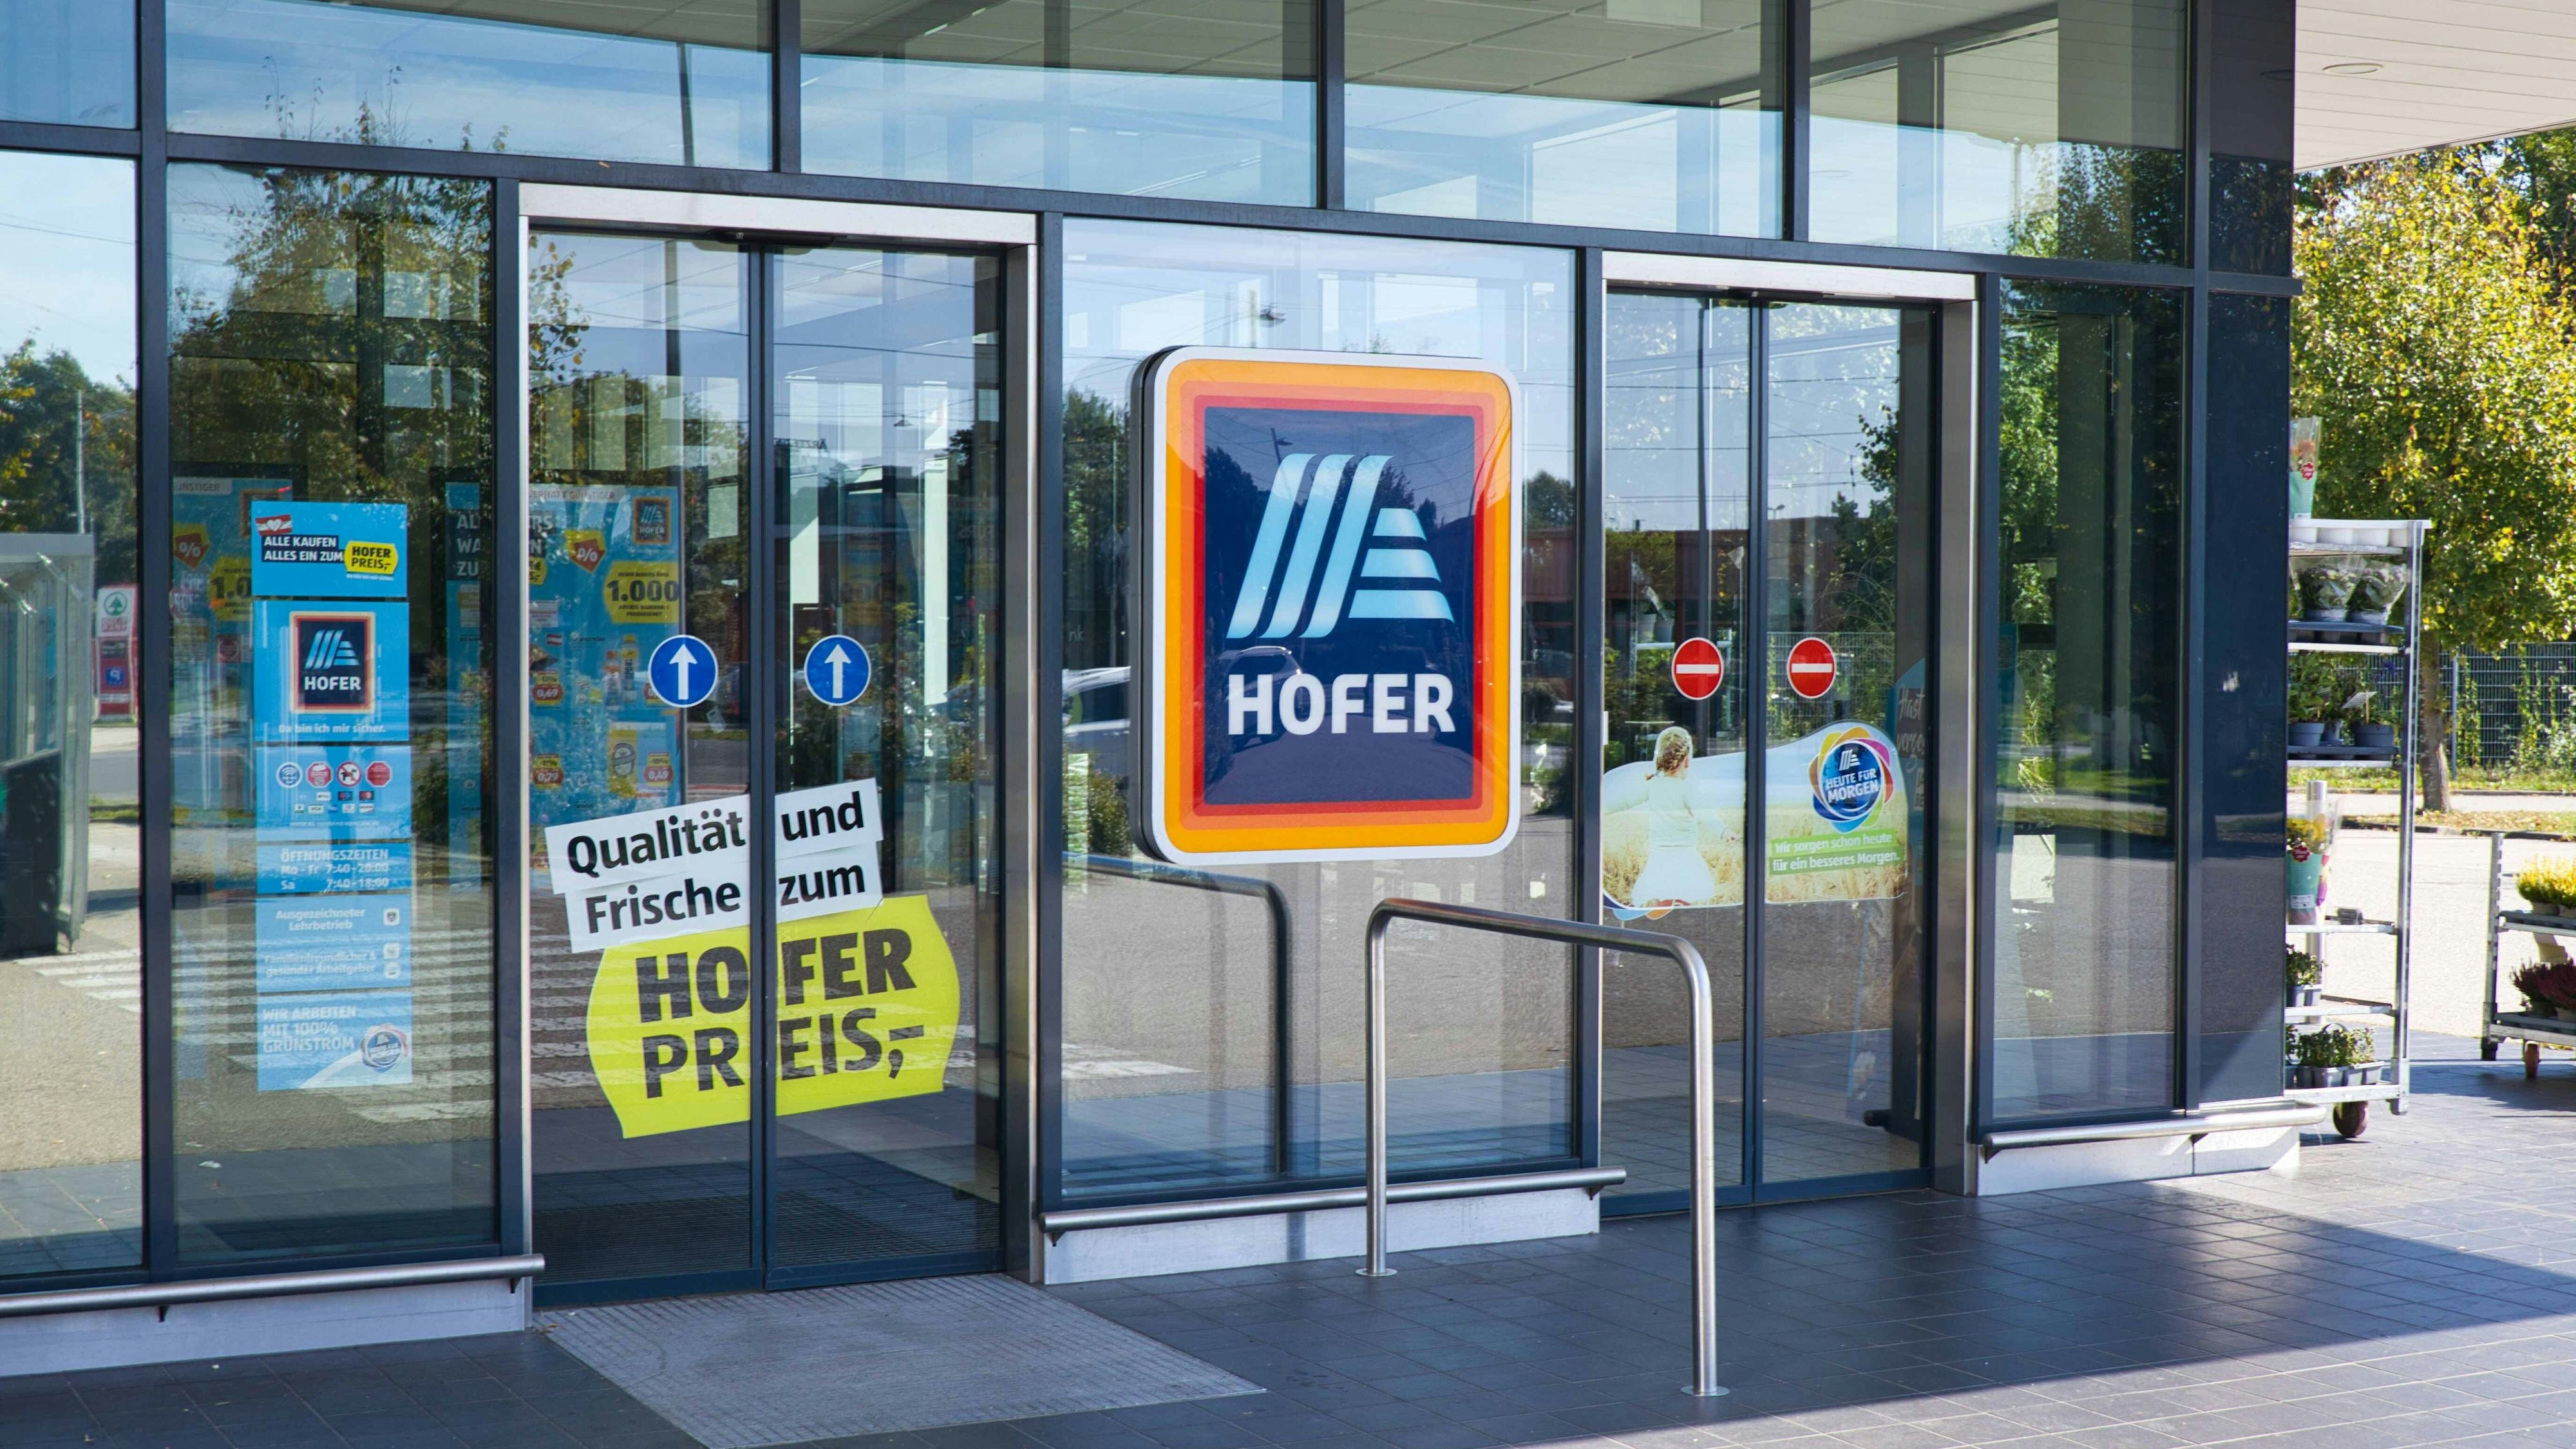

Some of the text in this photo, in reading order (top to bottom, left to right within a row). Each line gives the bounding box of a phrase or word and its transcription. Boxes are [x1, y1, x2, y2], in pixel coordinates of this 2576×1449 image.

[457, 515, 479, 529] AL
[264, 536, 336, 547] ALLE KAUFEN
[264, 551, 343, 561] ALLES EIN ZUM
[352, 546, 390, 558] HOFER
[352, 558, 391, 570] PREIS,-
[211, 576, 251, 599] 1.0
[607, 580, 679, 601] 1.000
[305, 676, 361, 690] HOFER
[1227, 674, 1456, 735] HOFER
[295, 724, 312, 732] bin
[315, 724, 330, 732] ich
[333, 724, 350, 732] mir
[354, 723, 386, 732] sicher.
[1825, 769, 1877, 788] HEUTE FÜR
[1827, 781, 1879, 803] MORGEN
[567, 791, 865, 878] Qualität und
[1794, 841, 1829, 853] sorgen
[1831, 836, 1861, 848] schon
[1862, 833, 1892, 844] heute
[280, 848, 388, 862] ÖFFNUNGSZEITEN
[1772, 851, 1899, 871] für ein besseres Morgen.
[281, 865, 298, 875] Mo
[307, 865, 319, 874] Fr
[281, 880, 295, 890] Sa
[585, 864, 866, 934] Frische zum
[276, 908, 366, 920] Ausgezeichneter
[289, 919, 353, 931] Lehrbetrieb
[634, 927, 916, 1023] HOFER
[263, 1005, 357, 1020] WIR ARBEITEN
[263, 1021, 339, 1037] MIT 100%
[263, 1036, 355, 1053] GRÜNSTROM
[641, 1007, 924, 1099] PREIS,-
